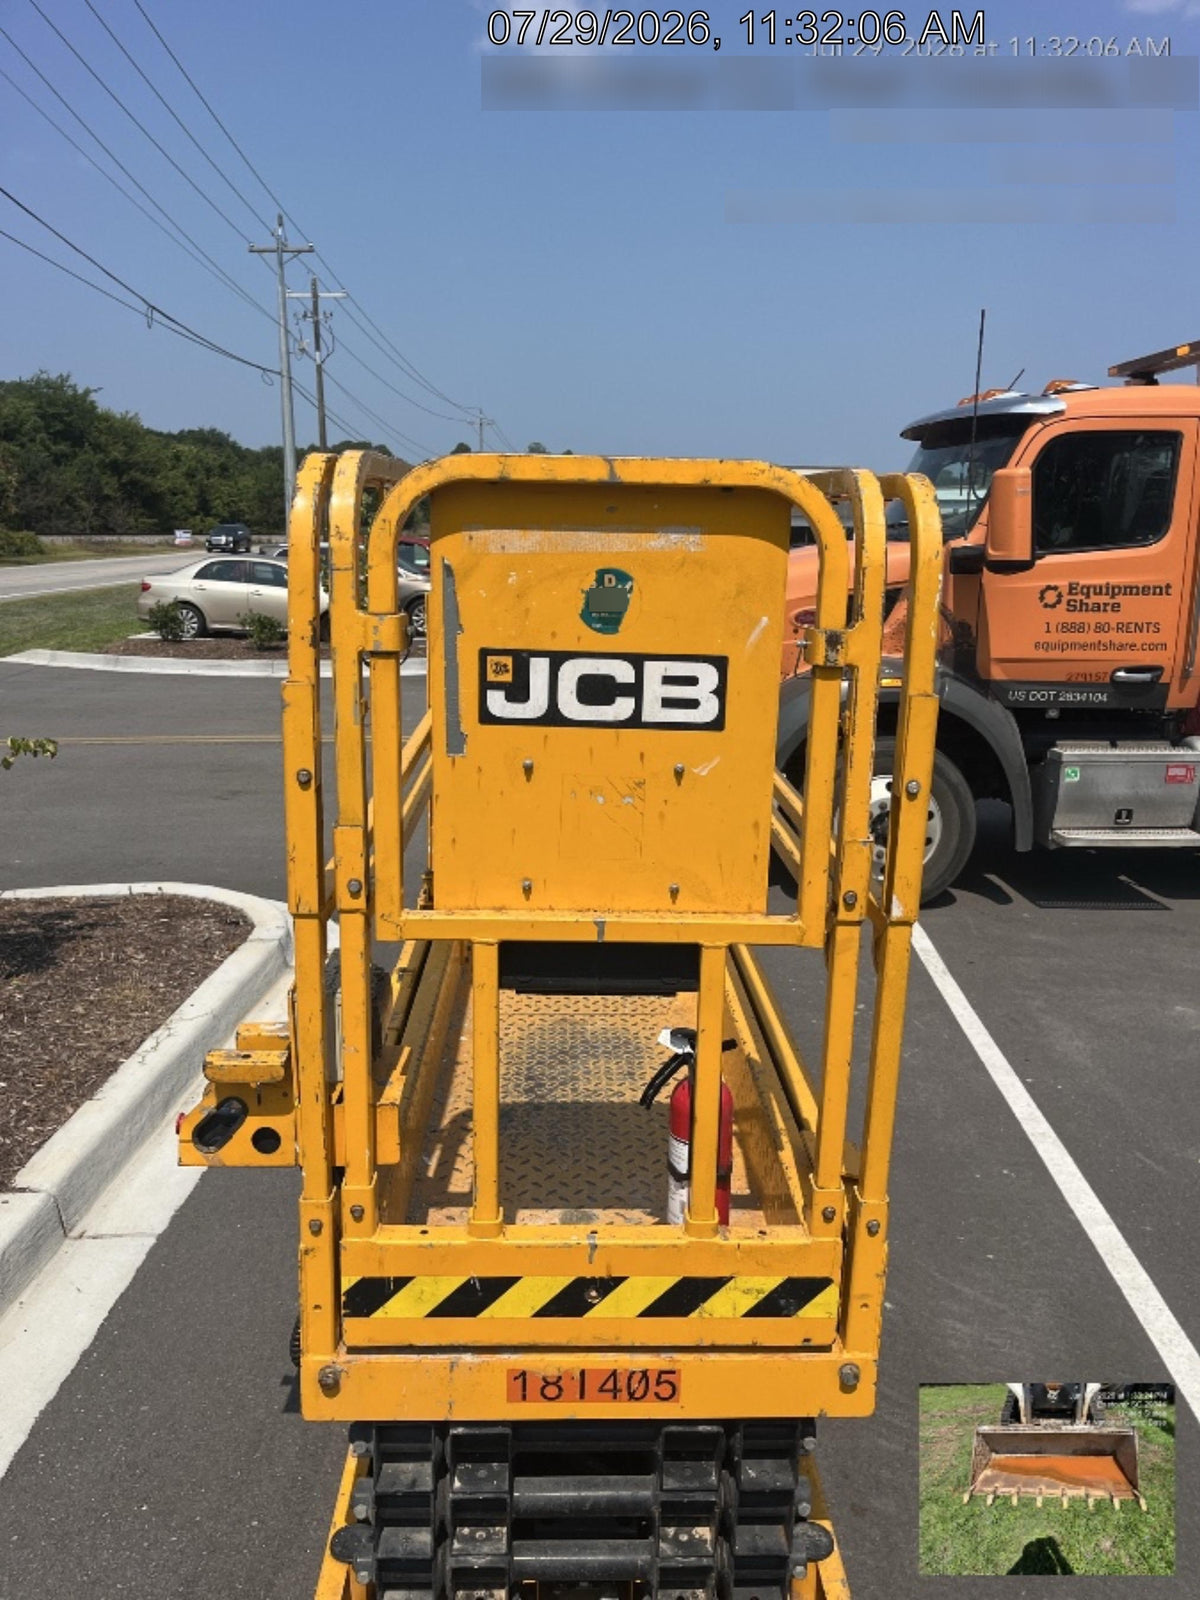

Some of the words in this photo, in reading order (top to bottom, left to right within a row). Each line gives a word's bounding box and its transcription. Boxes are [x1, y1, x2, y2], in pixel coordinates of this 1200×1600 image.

[1067, 582, 1172, 599] Equipment
[1066, 599, 1121, 613] Share
[1045, 622, 1051, 634] 1
[1055, 621, 1091, 635] (888)
[1093, 621, 1161, 634] 80-RENTS
[1034, 640, 1167, 653] equipmentshare.com
[487, 656, 720, 724] JCB
[1008, 690, 1026, 702] US
[1028, 690, 1057, 702] DOT
[512, 1369, 677, 1402] 181405
